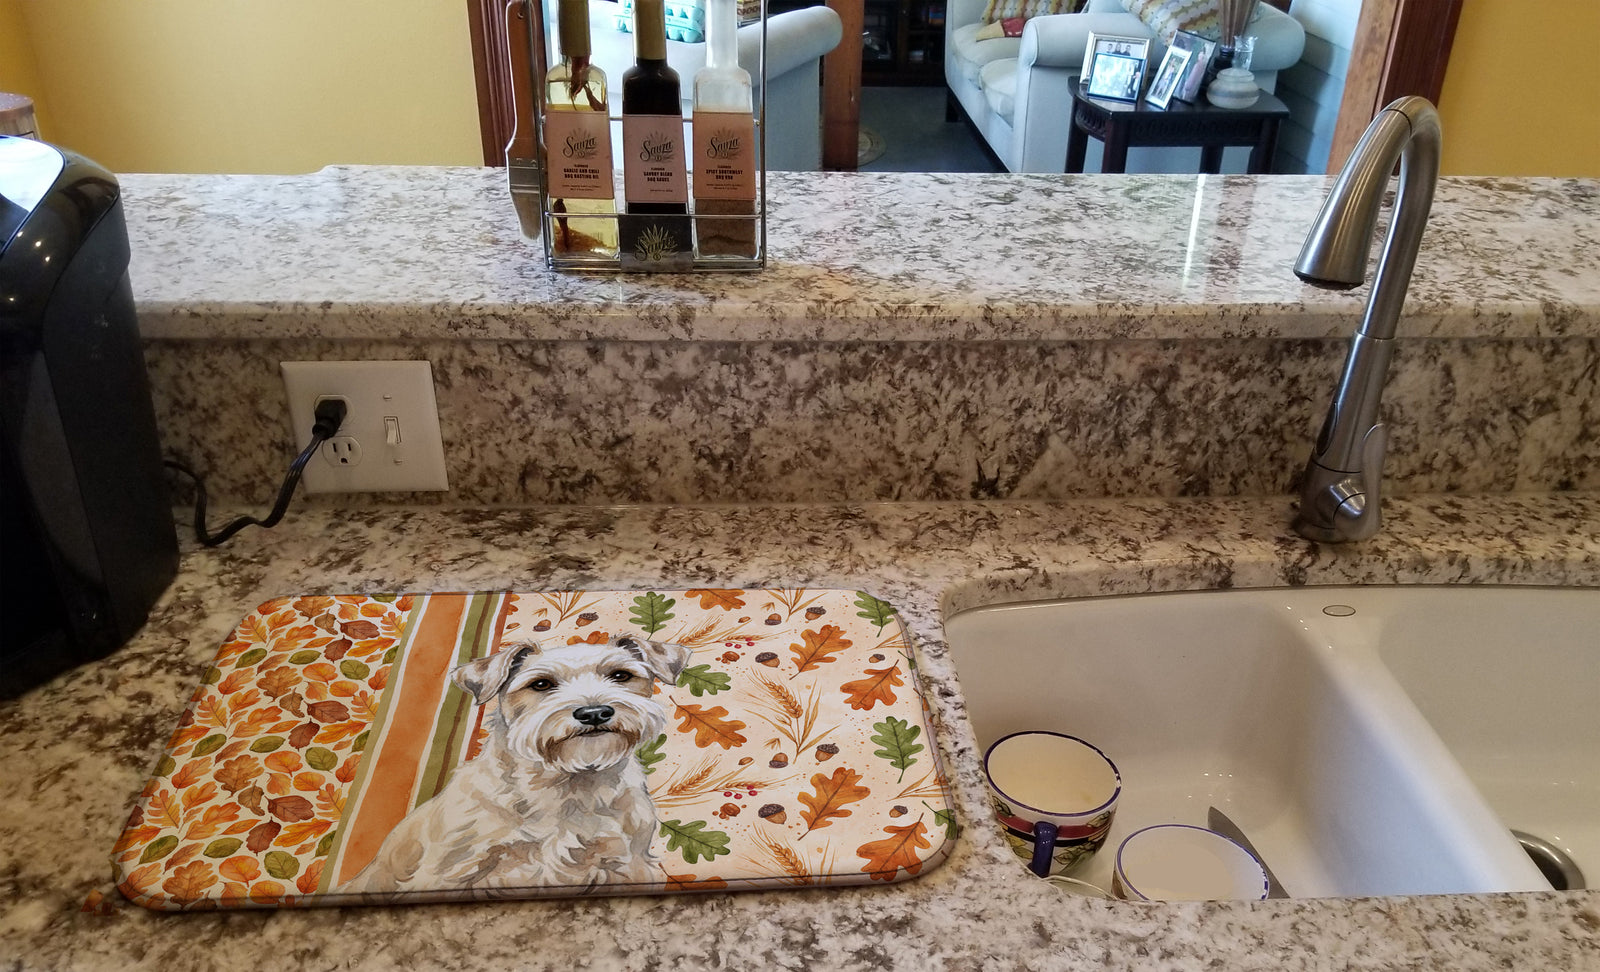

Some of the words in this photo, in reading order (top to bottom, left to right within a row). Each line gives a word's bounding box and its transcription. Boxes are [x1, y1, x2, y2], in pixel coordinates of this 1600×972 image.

[563, 136, 597, 158] Sauza
[640, 140, 673, 161] Sauza
[707, 137, 740, 159] Sauza
